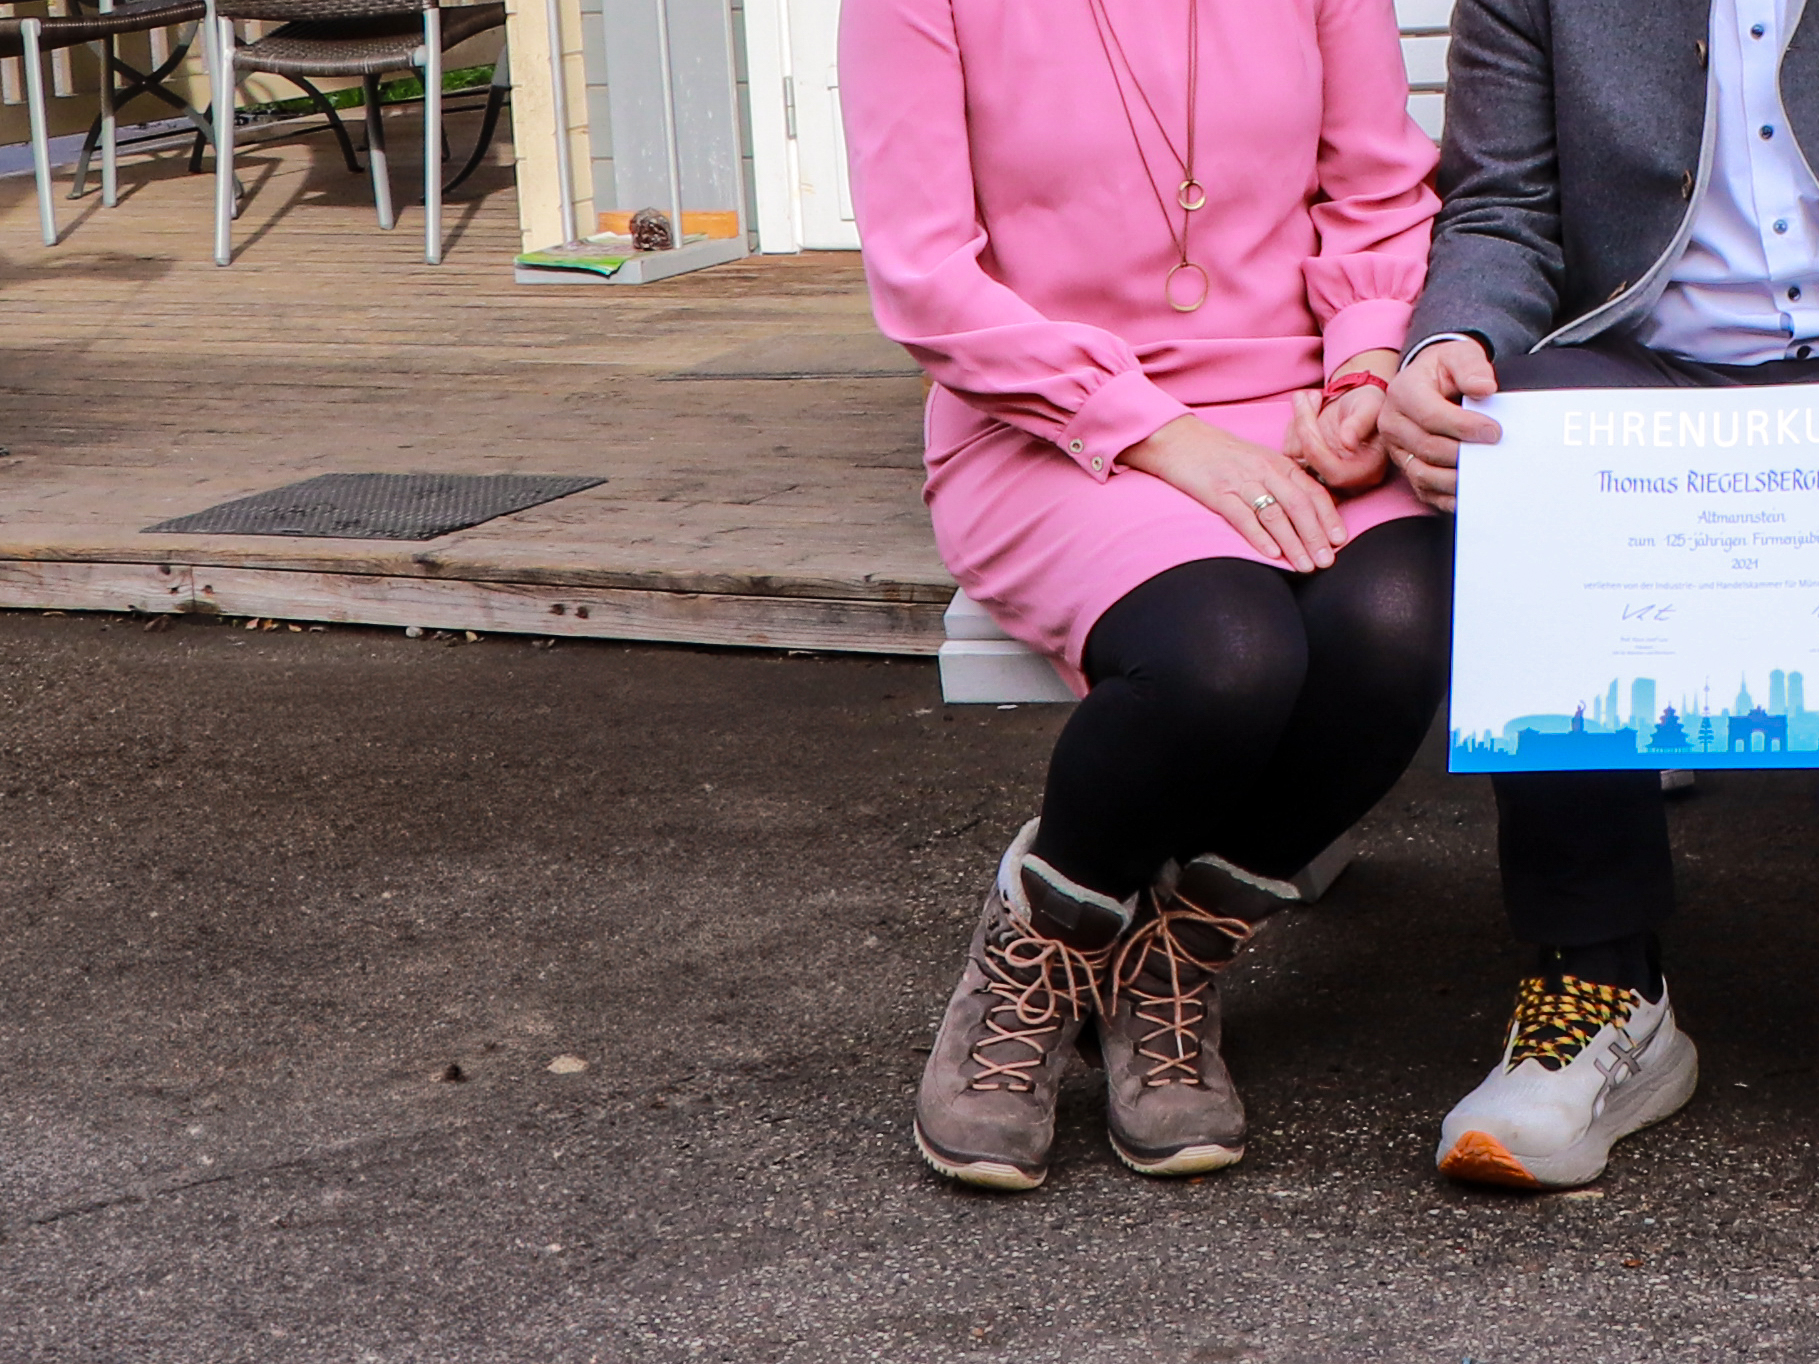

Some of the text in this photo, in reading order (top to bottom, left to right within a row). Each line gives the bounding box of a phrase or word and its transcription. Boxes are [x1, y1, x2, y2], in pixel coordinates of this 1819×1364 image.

[1594, 469, 1679, 494] Thomas
[1697, 507, 1787, 525] Altmannstein
[1627, 536, 1656, 547] zum
[1623, 582, 1639, 590] von
[1640, 581, 1654, 590] der
[1699, 581, 1714, 590] und
[1716, 580, 1783, 590] Handelskammer
